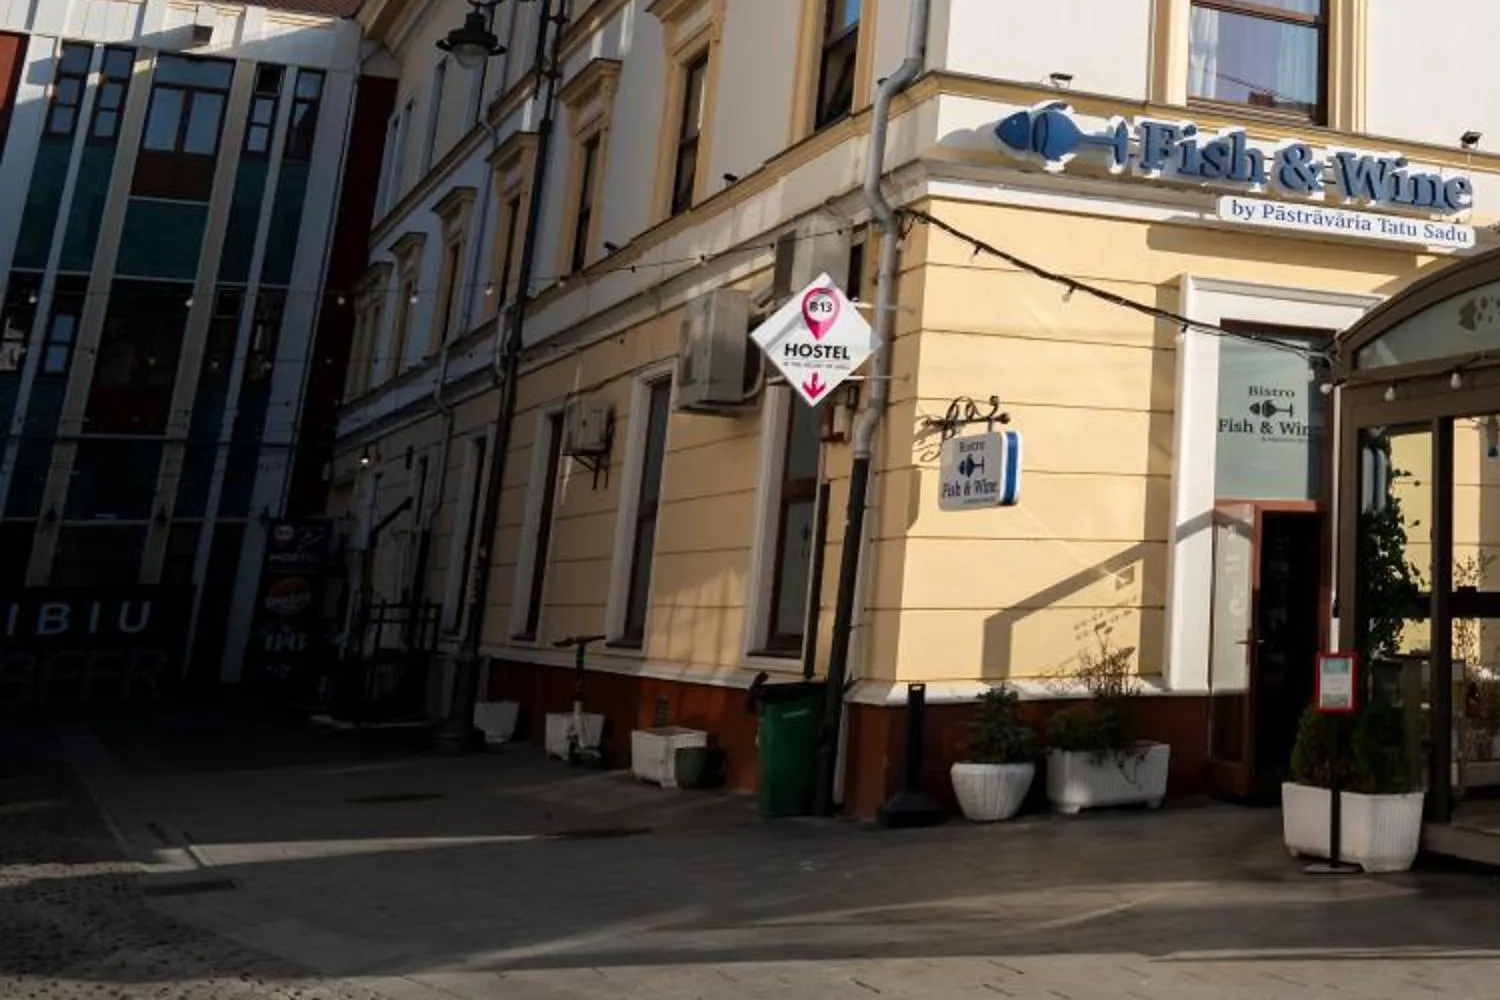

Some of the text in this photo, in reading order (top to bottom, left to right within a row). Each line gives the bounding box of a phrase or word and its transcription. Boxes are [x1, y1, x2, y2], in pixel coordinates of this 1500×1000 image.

[1138, 120, 1473, 214] Fish & Wine
[1232, 199, 1255, 220] by
[1377, 216, 1418, 237] Tatu
[1423, 223, 1469, 243] Sadu
[783, 343, 850, 361] HOSTEL
[1248, 385, 1296, 398] Bistro
[1218, 418, 1312, 437] Fish & Win
